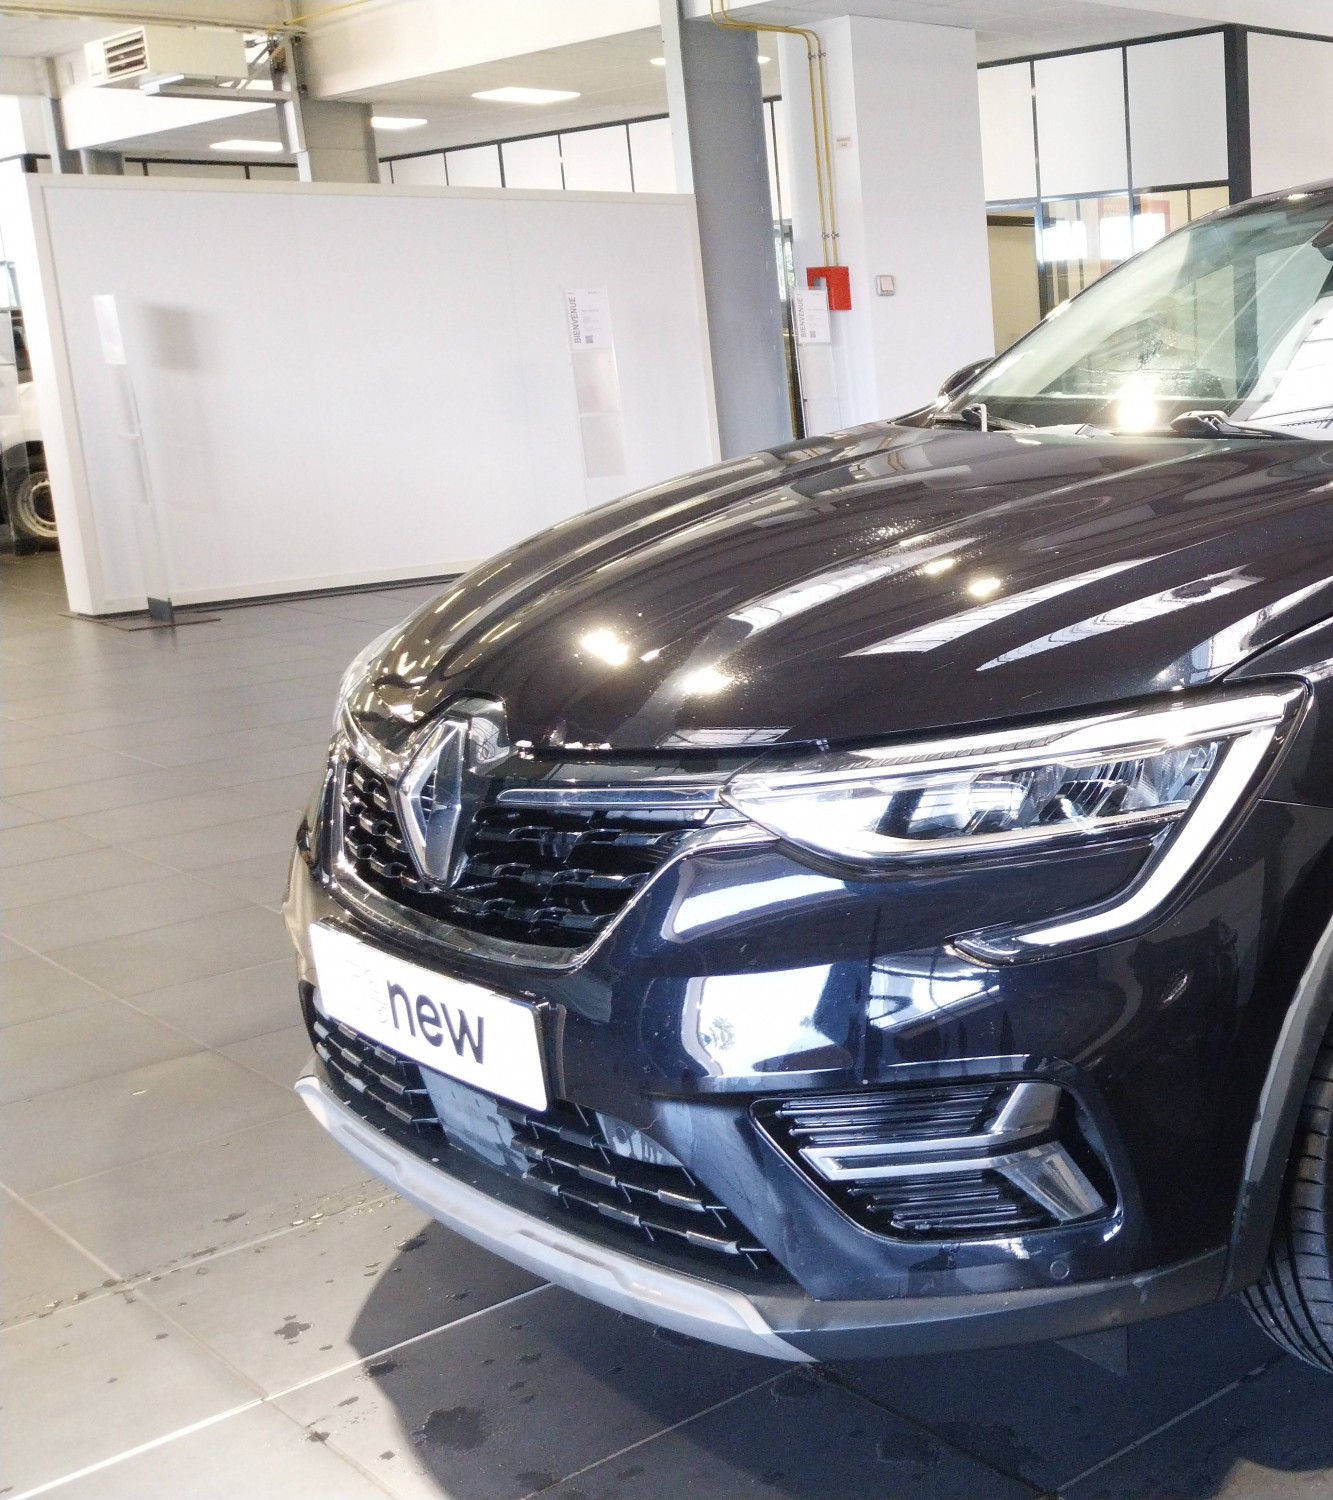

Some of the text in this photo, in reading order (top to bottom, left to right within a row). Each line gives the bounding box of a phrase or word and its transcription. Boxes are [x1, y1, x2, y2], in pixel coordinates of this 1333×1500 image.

[568, 297, 581, 344] BIENVENUE
[797, 297, 806, 338] BIENVENUE
[386, 980, 485, 1065] new
